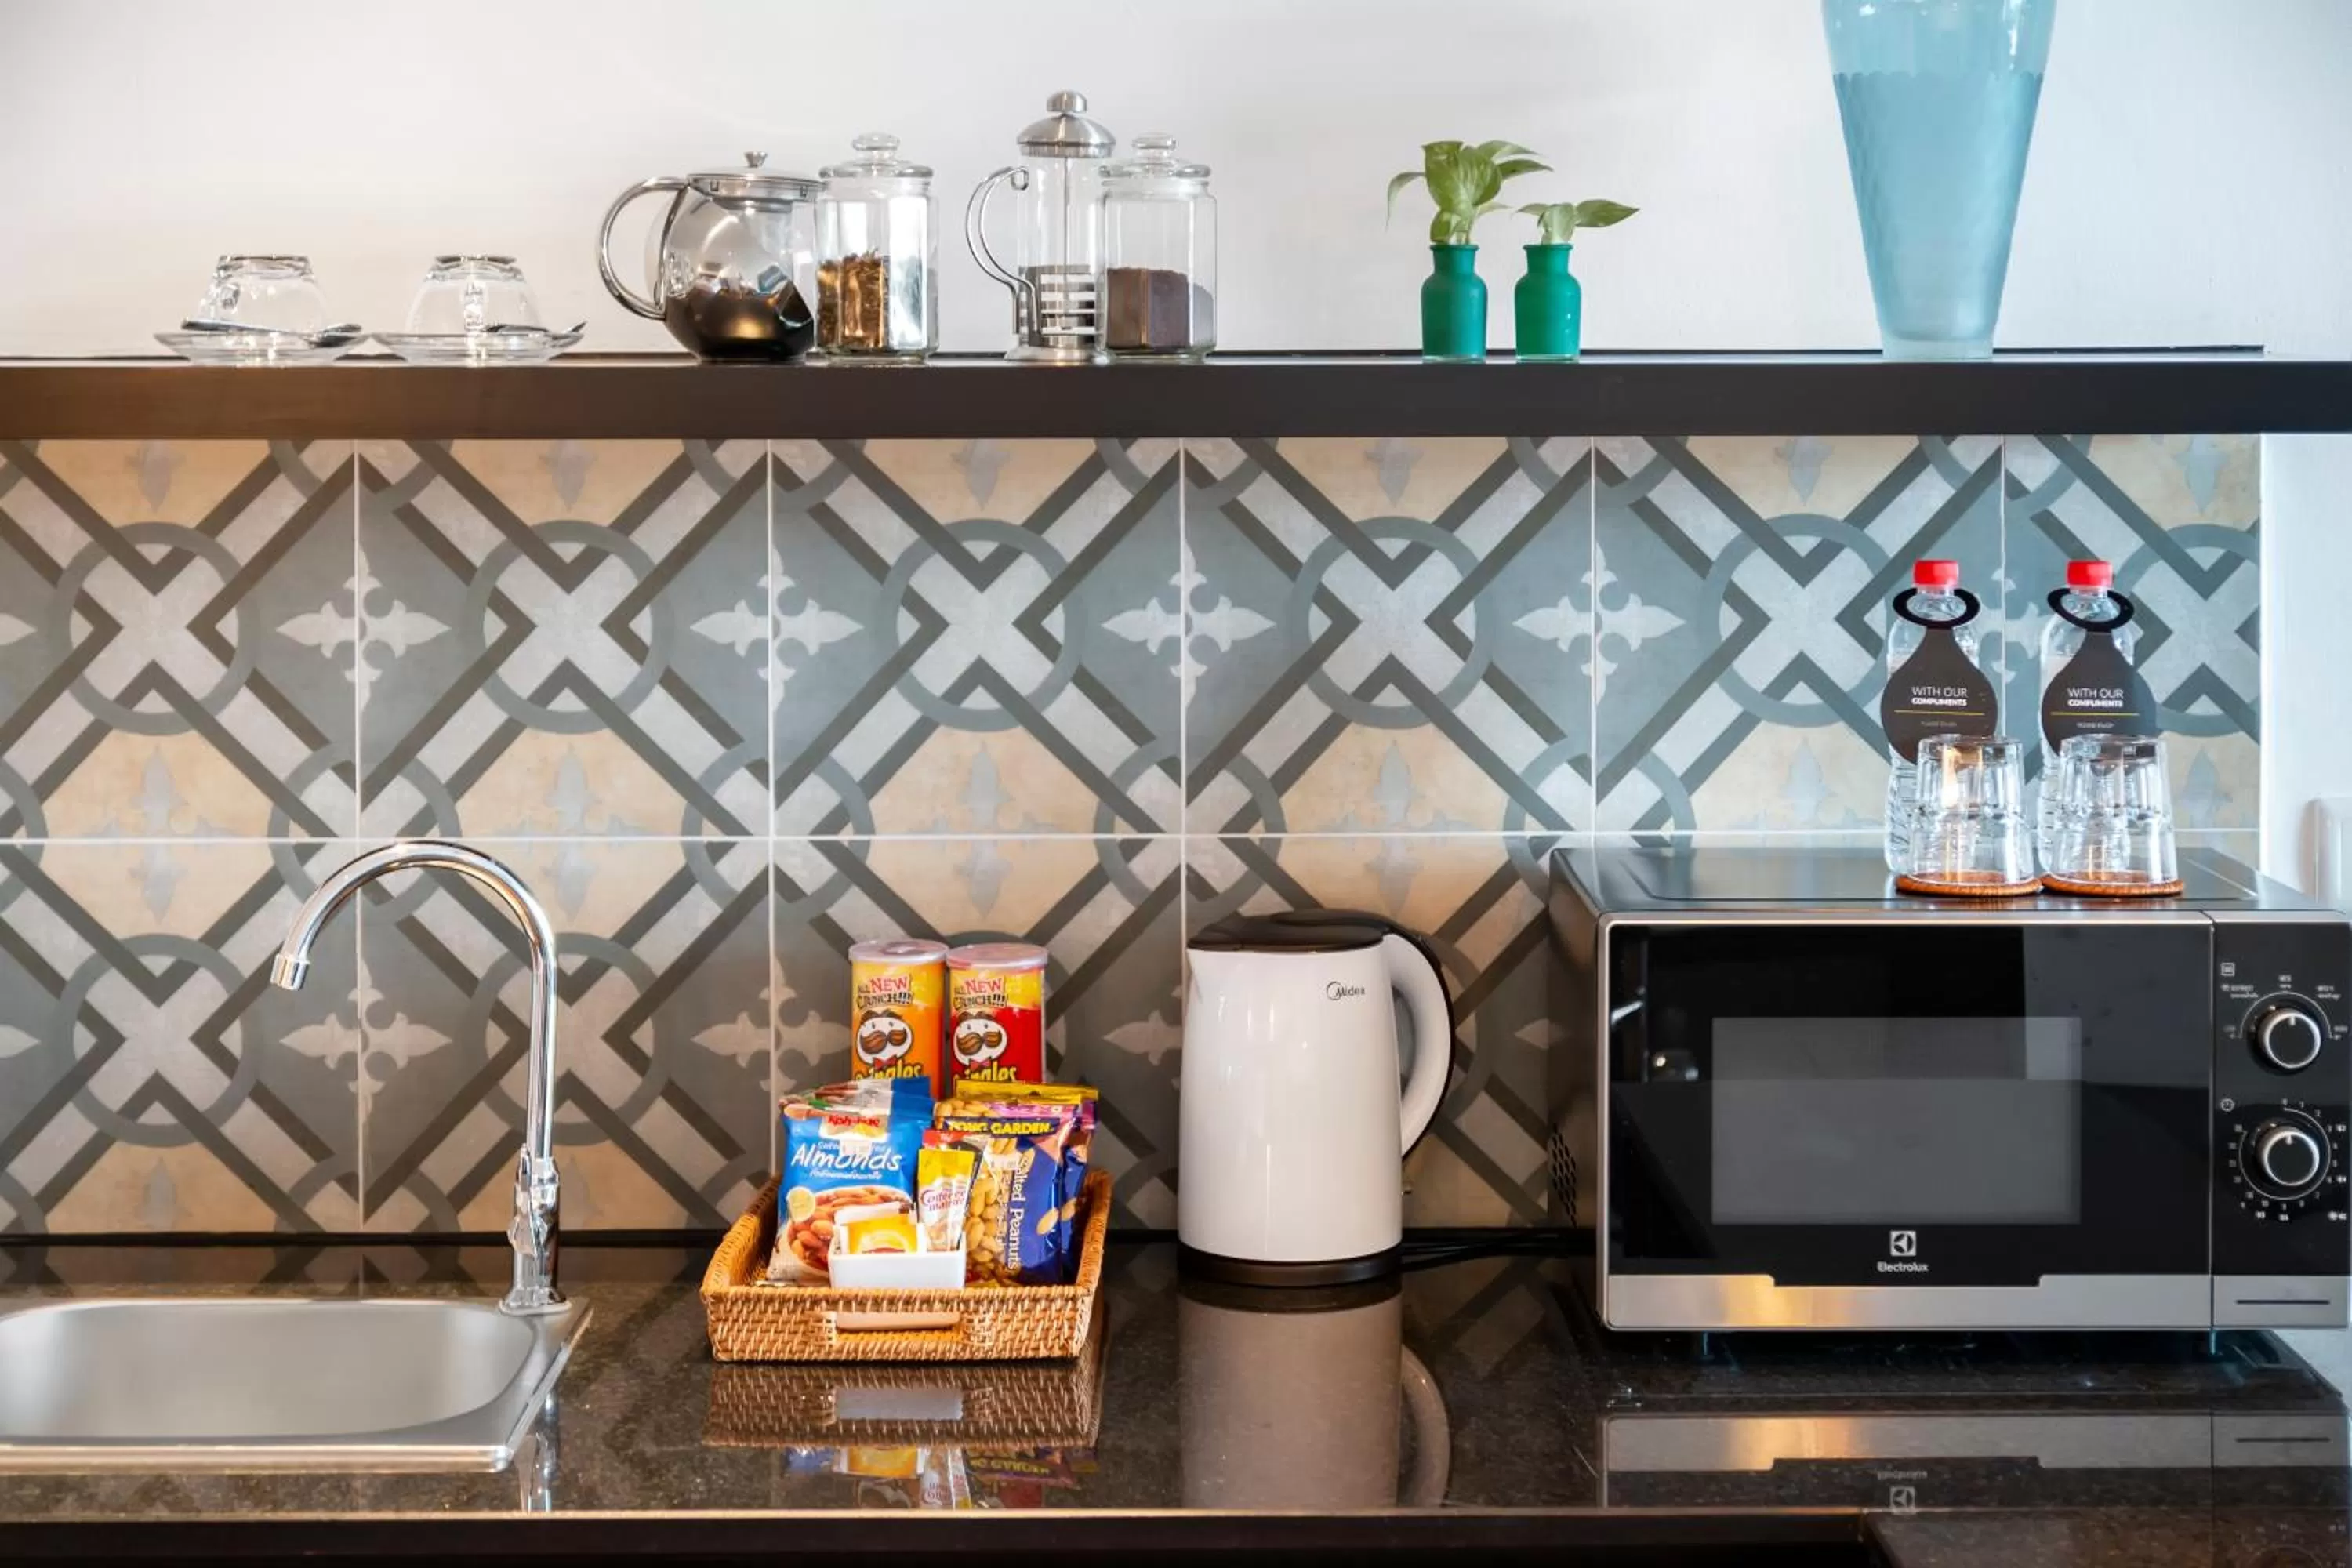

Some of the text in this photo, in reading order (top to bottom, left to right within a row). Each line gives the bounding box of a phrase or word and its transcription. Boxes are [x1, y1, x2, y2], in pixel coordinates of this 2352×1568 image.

[1911, 686, 1968, 698] WITH OUR
[2067, 688, 2124, 699] WITH OUR
[870, 977, 908, 993] NEW
[964, 978, 1002, 994] NEW
[991, 1123, 1051, 1135] GARDEN
[790, 1142, 902, 1171] Almonds
[1007, 1207, 1025, 1269] Peanuts
